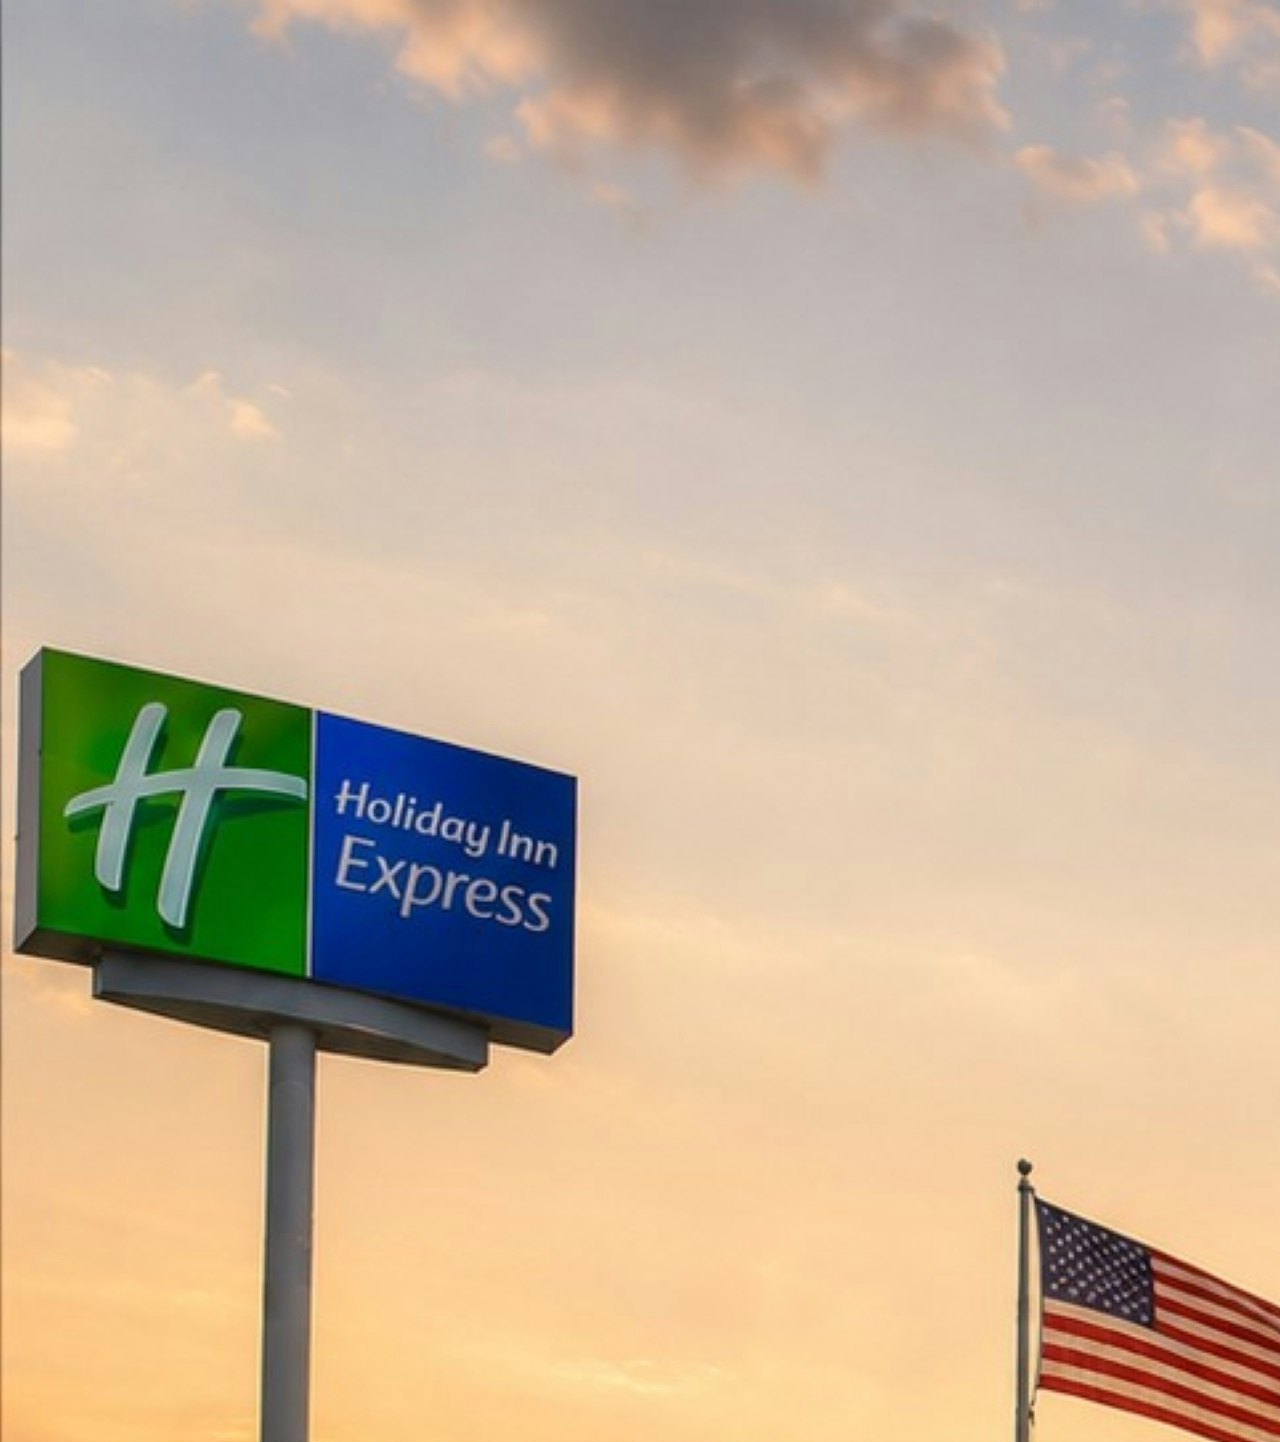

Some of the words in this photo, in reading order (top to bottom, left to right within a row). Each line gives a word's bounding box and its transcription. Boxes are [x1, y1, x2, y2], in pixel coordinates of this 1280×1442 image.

[334, 779, 489, 857] Holiday
[498, 819, 558, 868] Inn
[335, 834, 552, 931] Express
